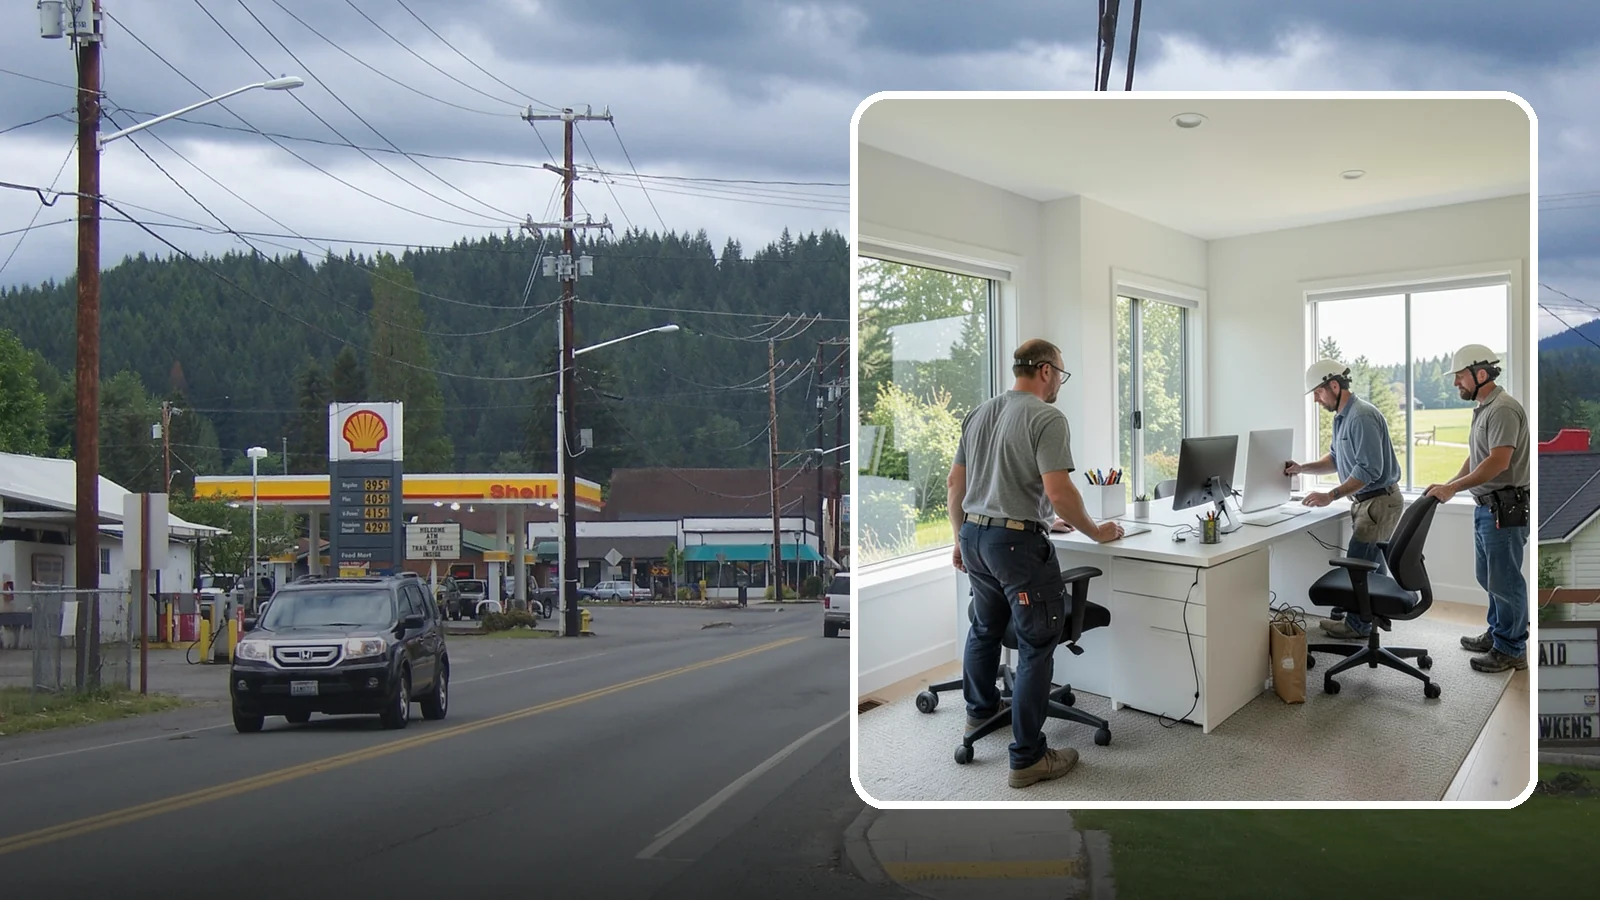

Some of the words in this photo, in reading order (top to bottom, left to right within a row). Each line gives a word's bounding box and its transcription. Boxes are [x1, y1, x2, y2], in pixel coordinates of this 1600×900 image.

[365, 480, 384, 490] 395
[490, 484, 547, 499] Shell
[365, 494, 384, 504] 405
[365, 508, 384, 518] 415
[365, 522, 384, 532] 429
